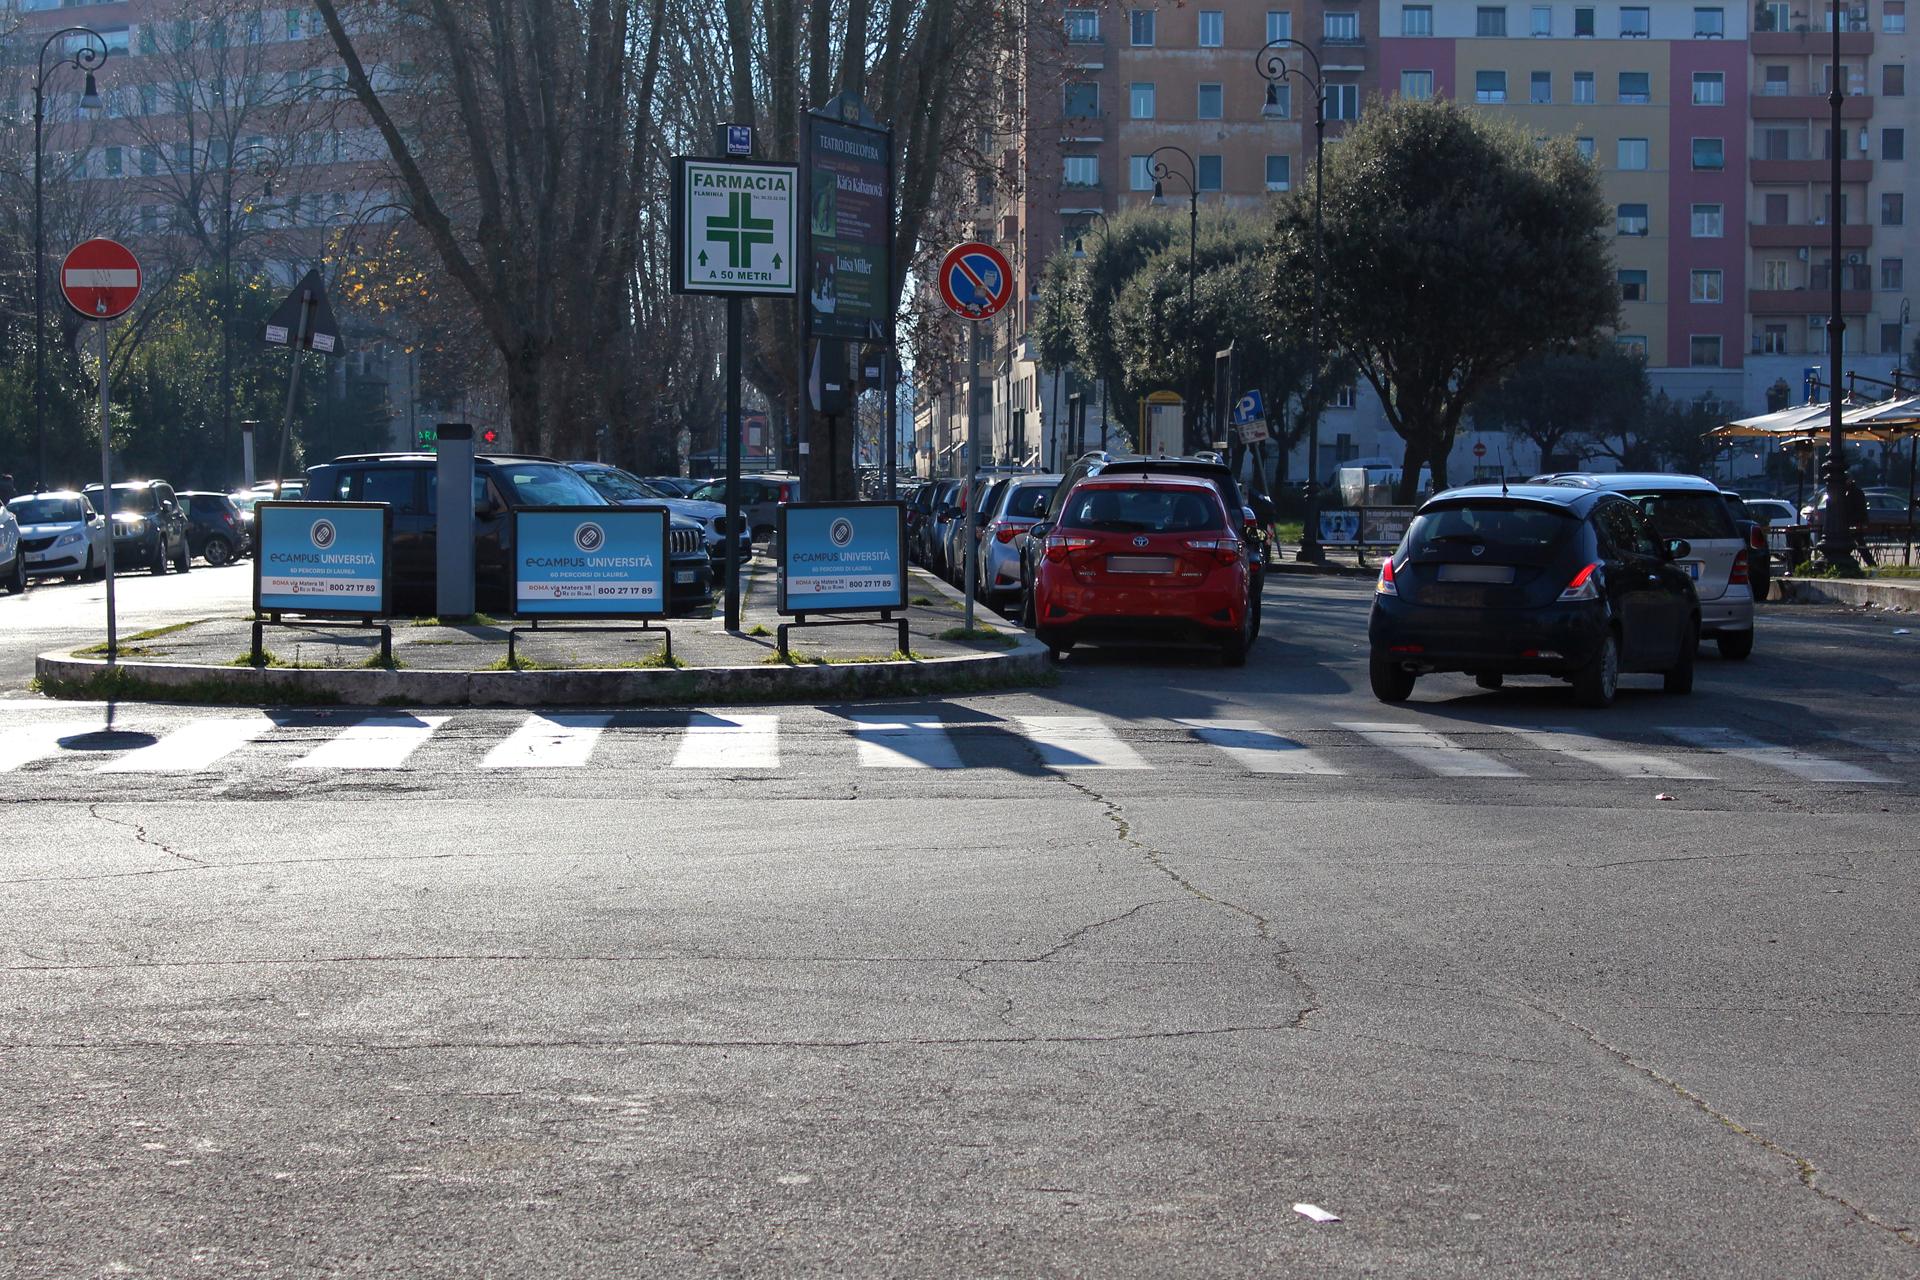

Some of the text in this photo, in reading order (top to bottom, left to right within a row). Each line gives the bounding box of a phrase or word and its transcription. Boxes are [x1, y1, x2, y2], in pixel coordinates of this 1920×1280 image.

[820, 135, 879, 160] TEATRO DELL'OPERA
[694, 173, 786, 191] FARMACIA
[837, 255, 873, 275] Luisa Miller
[709, 270, 772, 281] A 50 METRI
[1239, 396, 1255, 420] P
[321, 552, 375, 565] UNIVERSITÀ
[587, 555, 653, 567] UNIVERSITÀ
[840, 548, 891, 561] UNIVERSITÀ
[598, 587, 616, 595] 800
[617, 587, 628, 595] 27
[641, 587, 653, 595] 89
